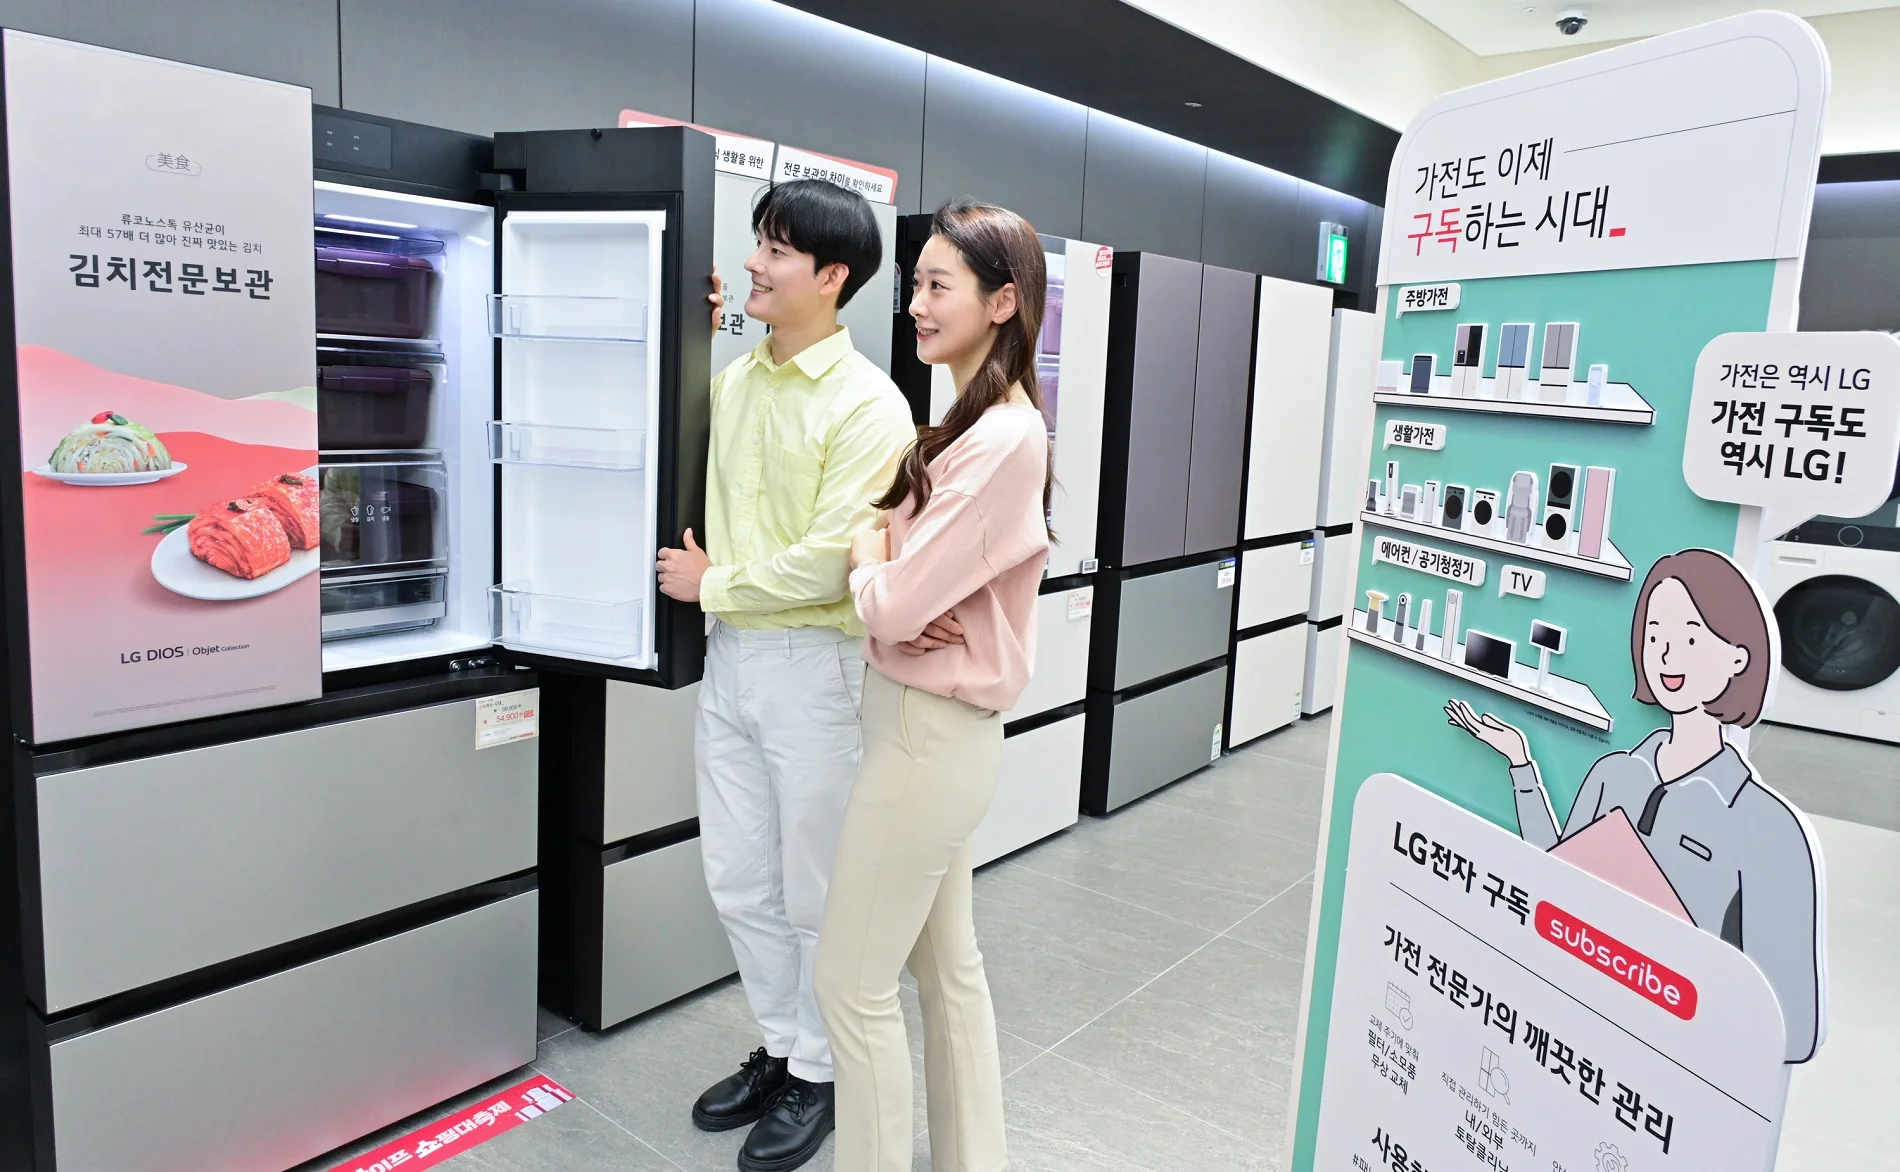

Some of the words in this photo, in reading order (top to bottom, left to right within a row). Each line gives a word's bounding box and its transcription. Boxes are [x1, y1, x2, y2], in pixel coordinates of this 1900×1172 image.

[157, 152, 191, 171] 美食
[722, 149, 746, 166] 생활을
[748, 155, 764, 169] 위한
[783, 162, 800, 177] 전문
[802, 167, 828, 181] 보관의
[829, 172, 851, 187] 차이를
[852, 179, 883, 193] 확인하세요
[1415, 155, 1486, 201] 가전도
[1498, 137, 1553, 185] 이제
[78, 225, 102, 238] 최대
[107, 229, 134, 242] 57배
[139, 231, 150, 244] 더
[154, 233, 177, 246] 많아
[181, 236, 203, 249] 진짜
[207, 238, 238, 252] 맛있는
[243, 242, 262, 254] 김치
[121, 214, 178, 230] 류코노스톡
[182, 220, 225, 236] 유산균이
[1407, 201, 1526, 257] 구독하는
[69, 253, 274, 300] 김치전문보관
[1405, 287, 1448, 308] 주방가전
[1720, 363, 1780, 389] 가전은
[1788, 365, 1831, 391] 역시
[1838, 368, 1871, 390] LG
[1392, 424, 1435, 446] 생활가전
[1711, 400, 1766, 435] 가전
[1774, 404, 1866, 441] 구독도
[1720, 441, 1774, 479] 역시
[1783, 447, 1846, 484] LG!
[1511, 572, 1532, 592] TV
[121, 651, 141, 664] LG
[147, 646, 184, 661] DIOS
[192, 645, 220, 656] Objet
[221, 643, 250, 652] Collection
[1393, 821, 1477, 894] LG전자
[1483, 872, 1530, 926] 구독
[1550, 919, 1681, 1006] subscribe
[1369, 1014, 1382, 1032] 교체
[1384, 1025, 1403, 1049] 주기에
[1384, 924, 1421, 976] 가전
[1427, 954, 1517, 1045] 전문가의
[1523, 1020, 1606, 1106] 깨끗한
[1612, 1081, 1673, 1155] 관리
[1368, 1028, 1417, 1080] 필터/소모품
[1371, 1053, 1389, 1078] 무상
[1389, 1069, 1408, 1096] 교체
[1441, 1071, 1457, 1093] 직접
[1458, 1085, 1490, 1119] 관리하기
[1492, 1112, 1508, 1135] 힘든
[1510, 1127, 1537, 1157] 곳까지
[1465, 1110, 1504, 1151] 내/외부
[355, 1149, 413, 1172] 이프
[415, 1100, 513, 1159] 쇼핑대축제
[1372, 1127, 1429, 1172] 사용
